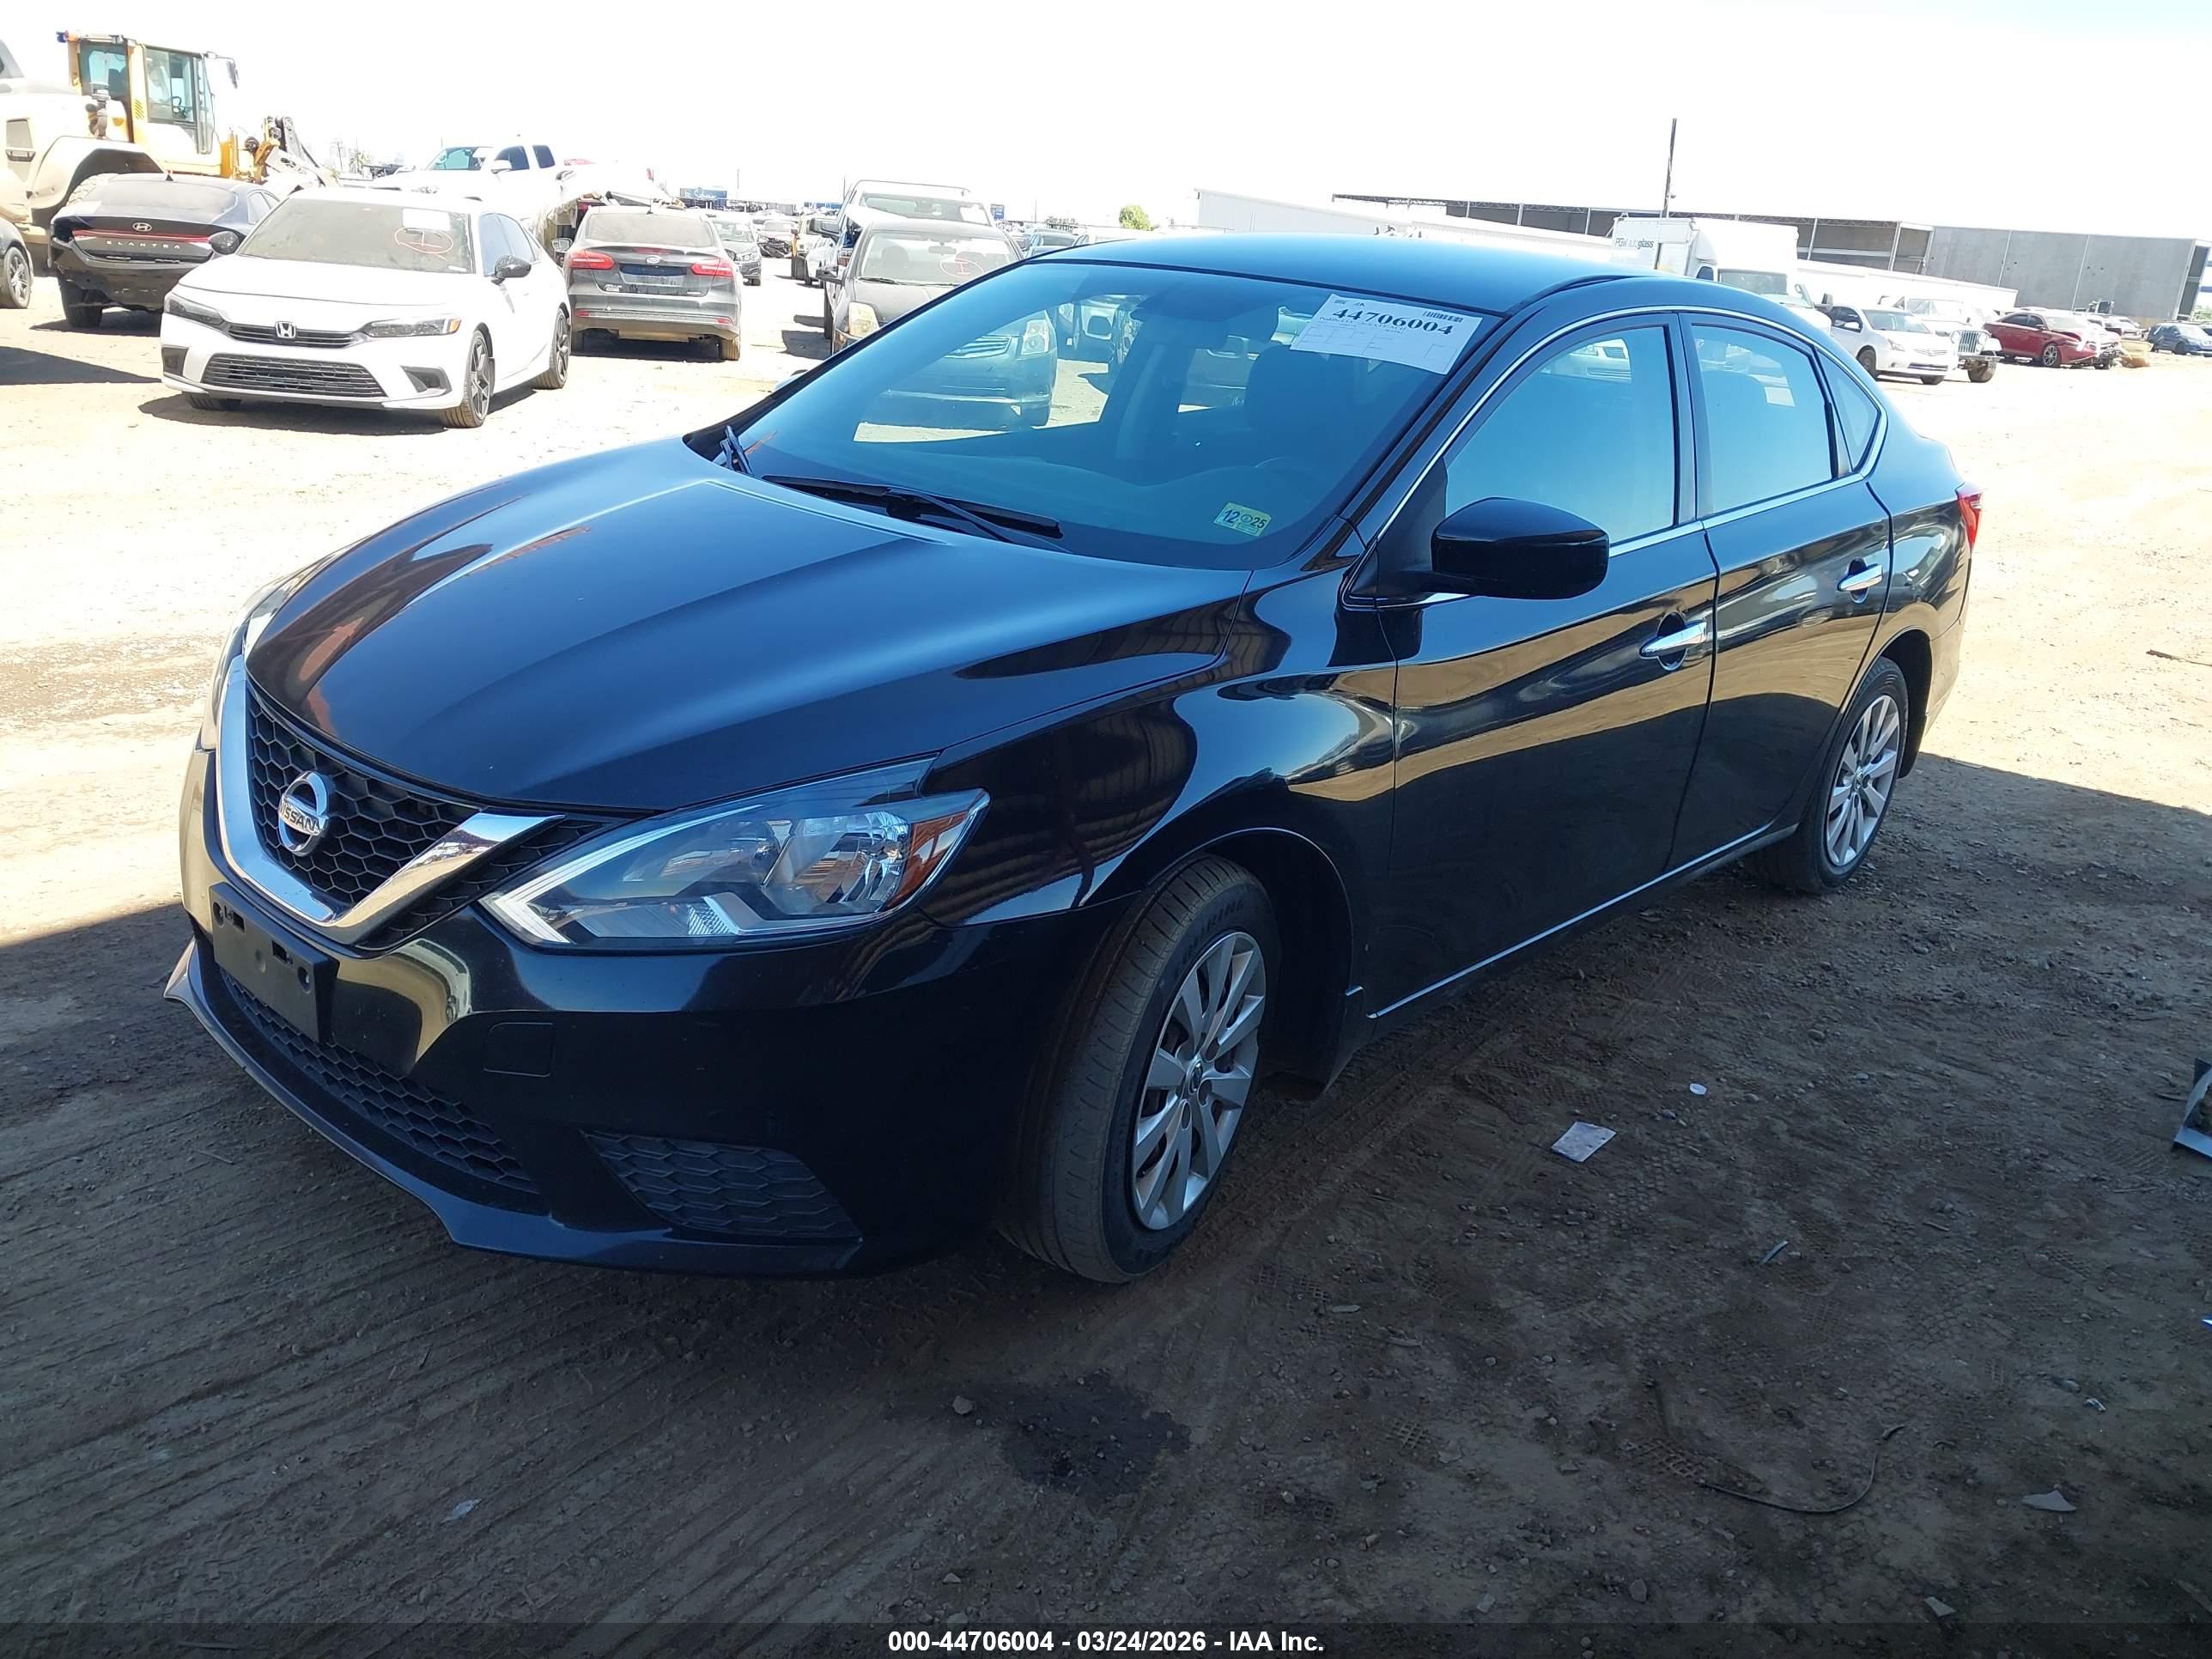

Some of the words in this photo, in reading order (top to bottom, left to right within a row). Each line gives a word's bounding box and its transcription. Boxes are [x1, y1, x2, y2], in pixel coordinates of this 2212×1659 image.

[1332, 308, 1454, 335] 44706004
[1223, 509, 1240, 523] 12
[1250, 517, 1267, 528] 25
